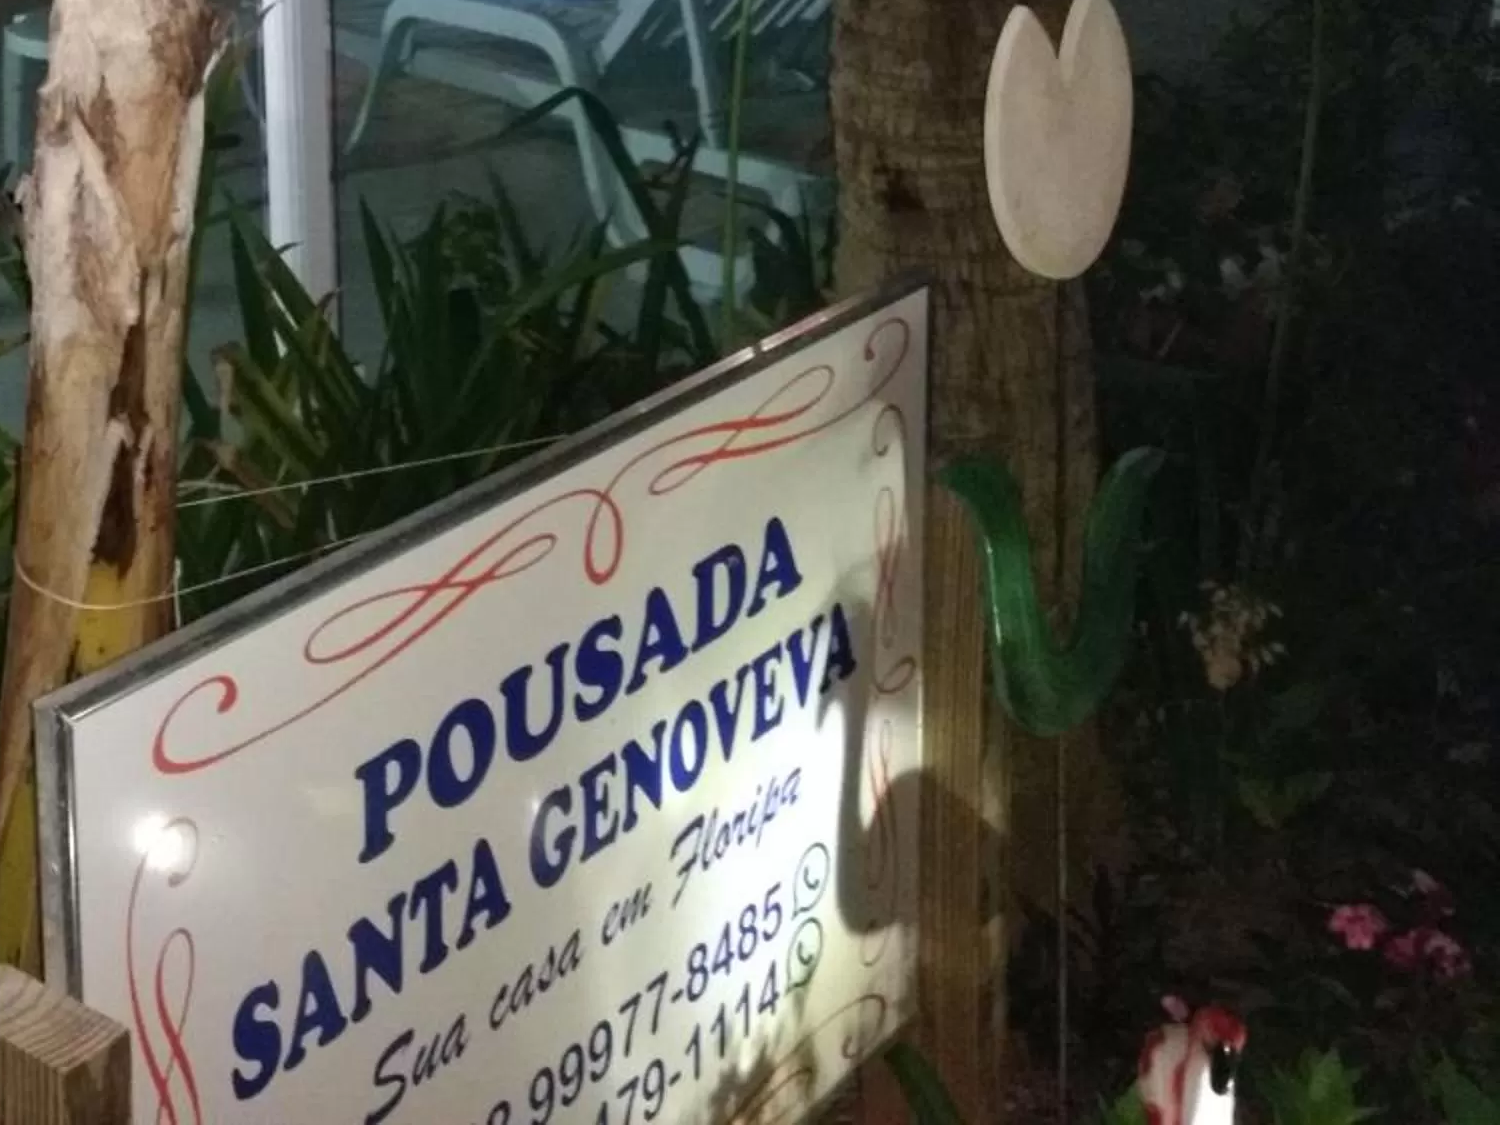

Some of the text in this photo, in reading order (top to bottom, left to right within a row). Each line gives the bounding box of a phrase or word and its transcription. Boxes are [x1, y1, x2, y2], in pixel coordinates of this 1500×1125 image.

[232, 602, 856, 1099] SANTA GENOVEVA
[355, 516, 802, 864] POUSADA
[364, 767, 801, 1125] Sua casa em Floripa
